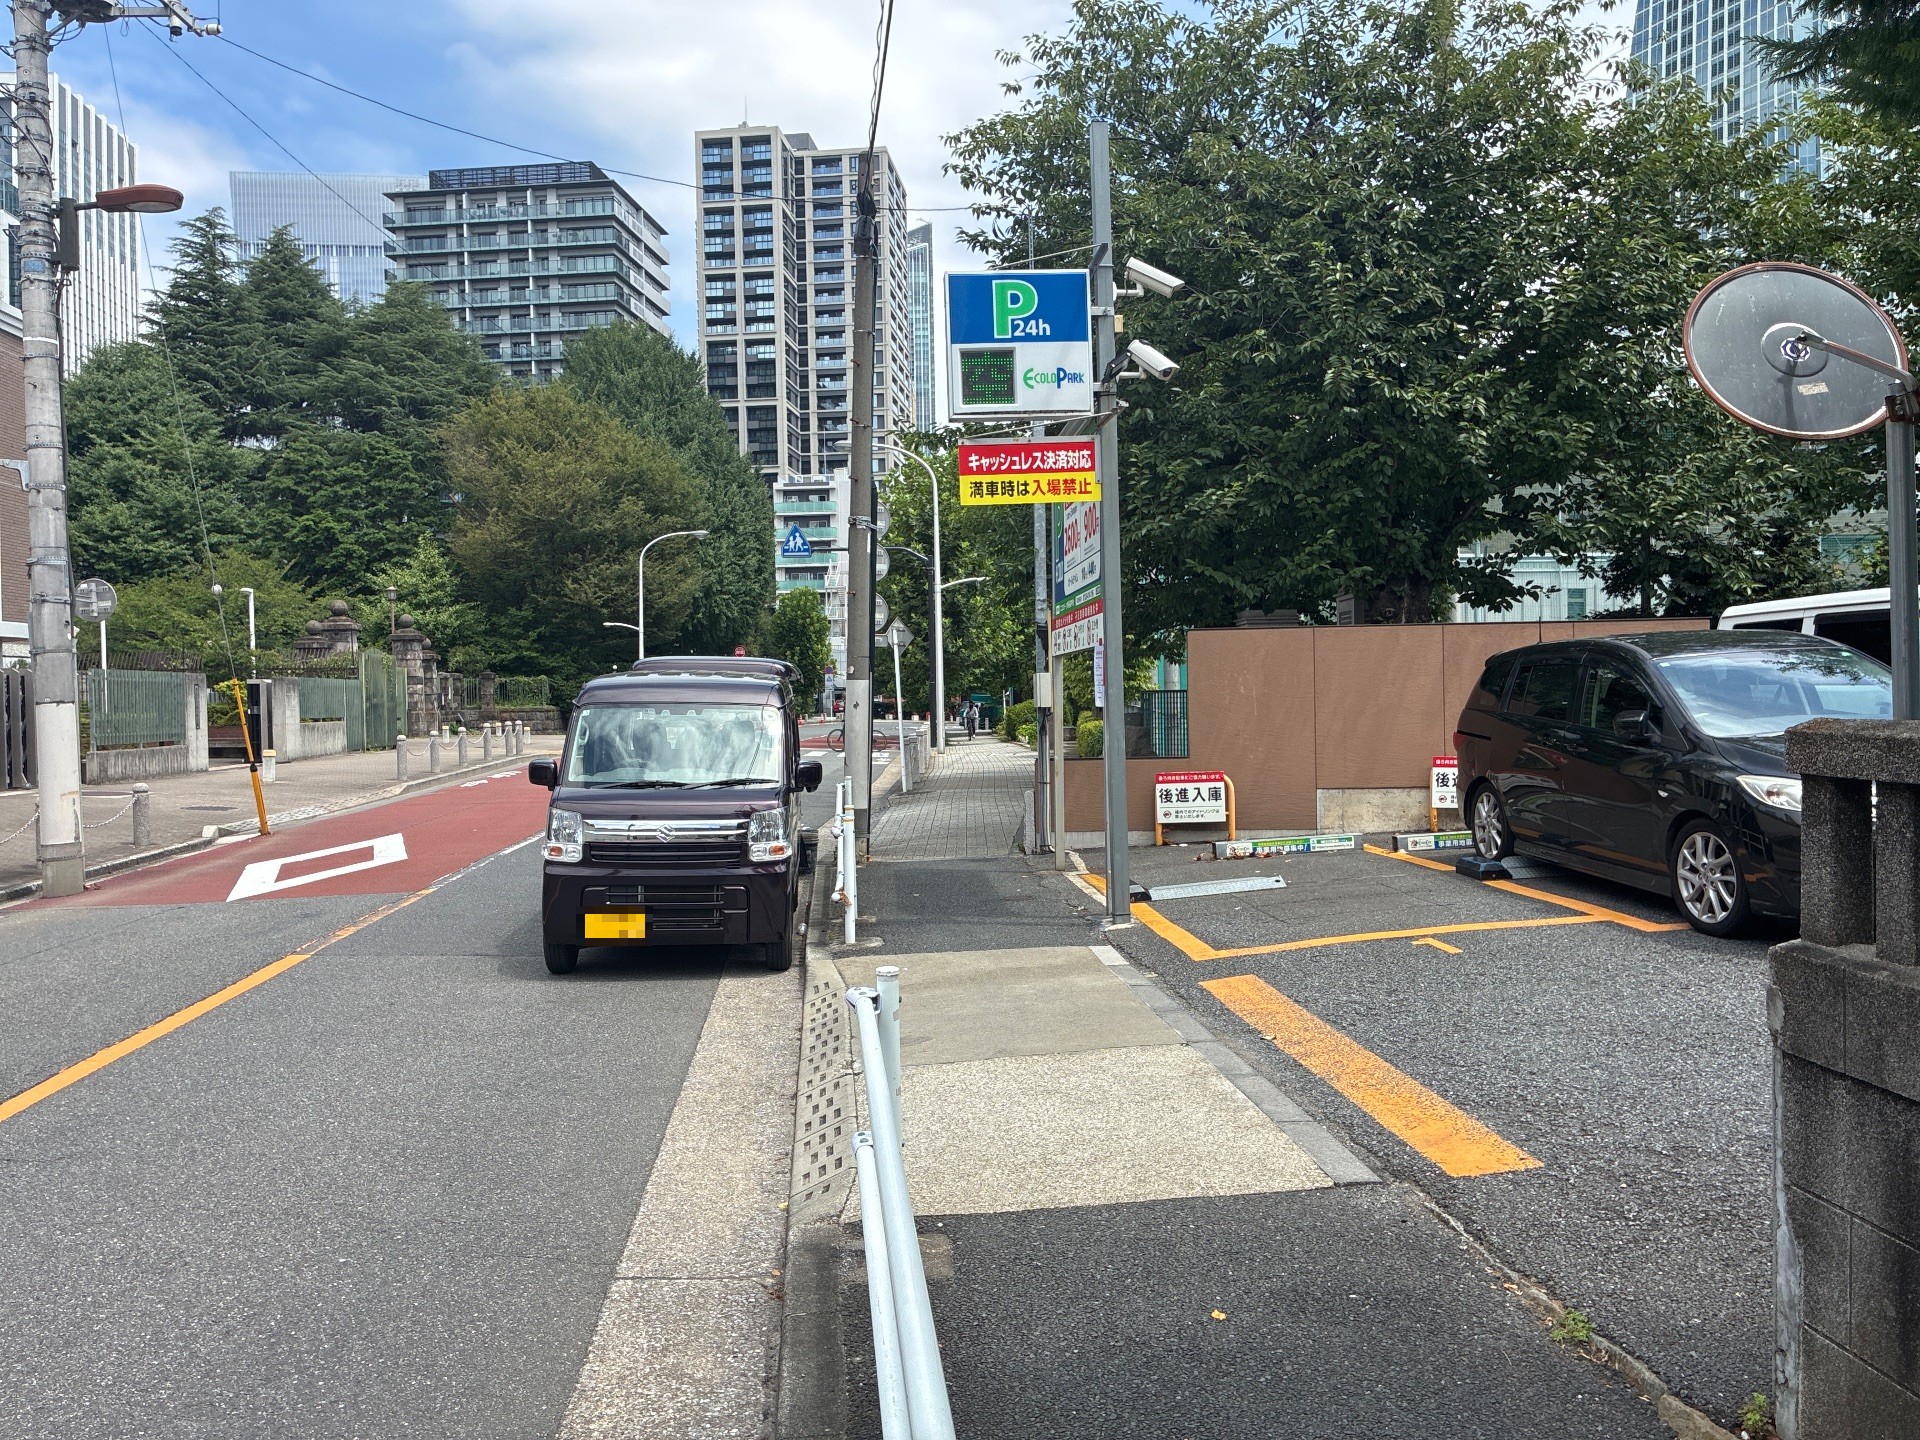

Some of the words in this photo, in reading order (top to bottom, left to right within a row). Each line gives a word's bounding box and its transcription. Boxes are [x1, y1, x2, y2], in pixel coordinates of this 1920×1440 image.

[992, 279, 1038, 338] P
[1013, 319, 1050, 336] 24h
[961, 352, 1014, 404] 空
[968, 449, 1092, 472] キャッシュレス決済対応
[969, 478, 1092, 498] 満車時は入場禁止
[1158, 786, 1222, 803] 後進入庫
